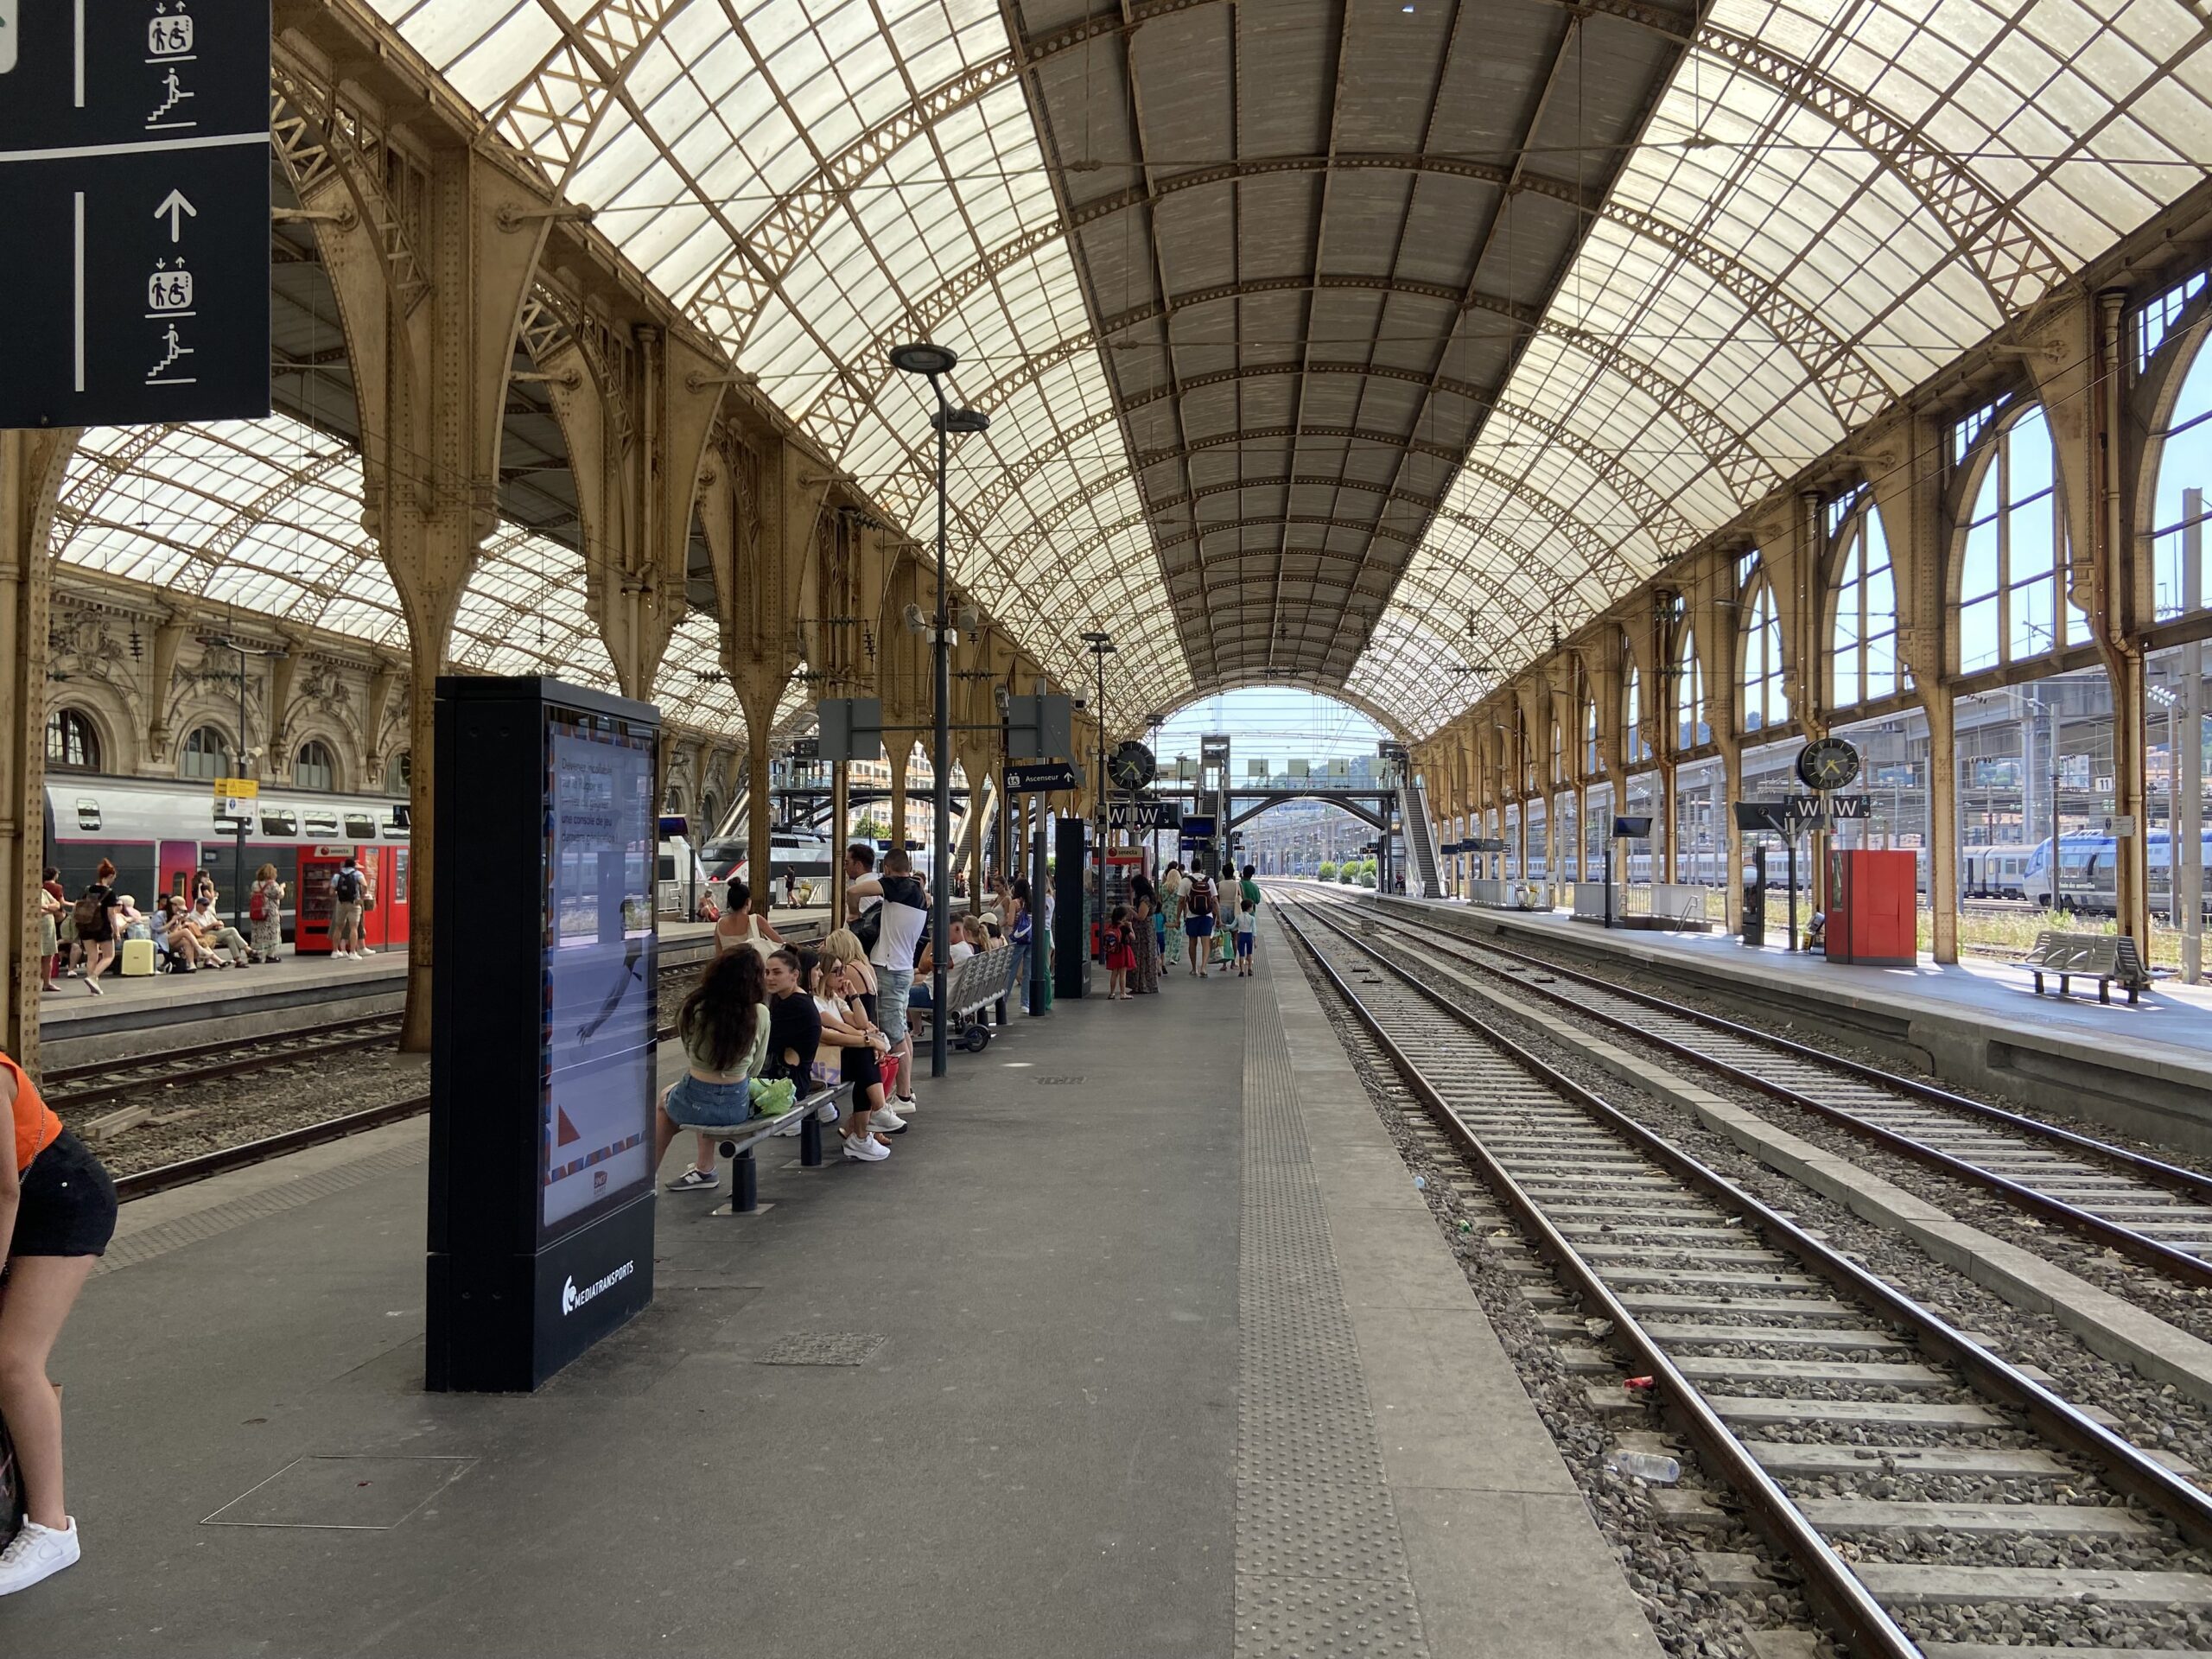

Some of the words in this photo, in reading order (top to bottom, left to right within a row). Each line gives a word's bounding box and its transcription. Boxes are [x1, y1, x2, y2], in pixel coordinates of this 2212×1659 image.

[2100, 779, 2109, 790] 11
[1109, 808, 1125, 823] W
[1139, 808, 1159, 823] W
[1797, 800, 1819, 817] W
[1835, 800, 1857, 817] W
[562, 815, 572, 824] une
[573, 814, 594, 825] console
[574, 1260, 634, 1309] MEDIATRANSPORTS
